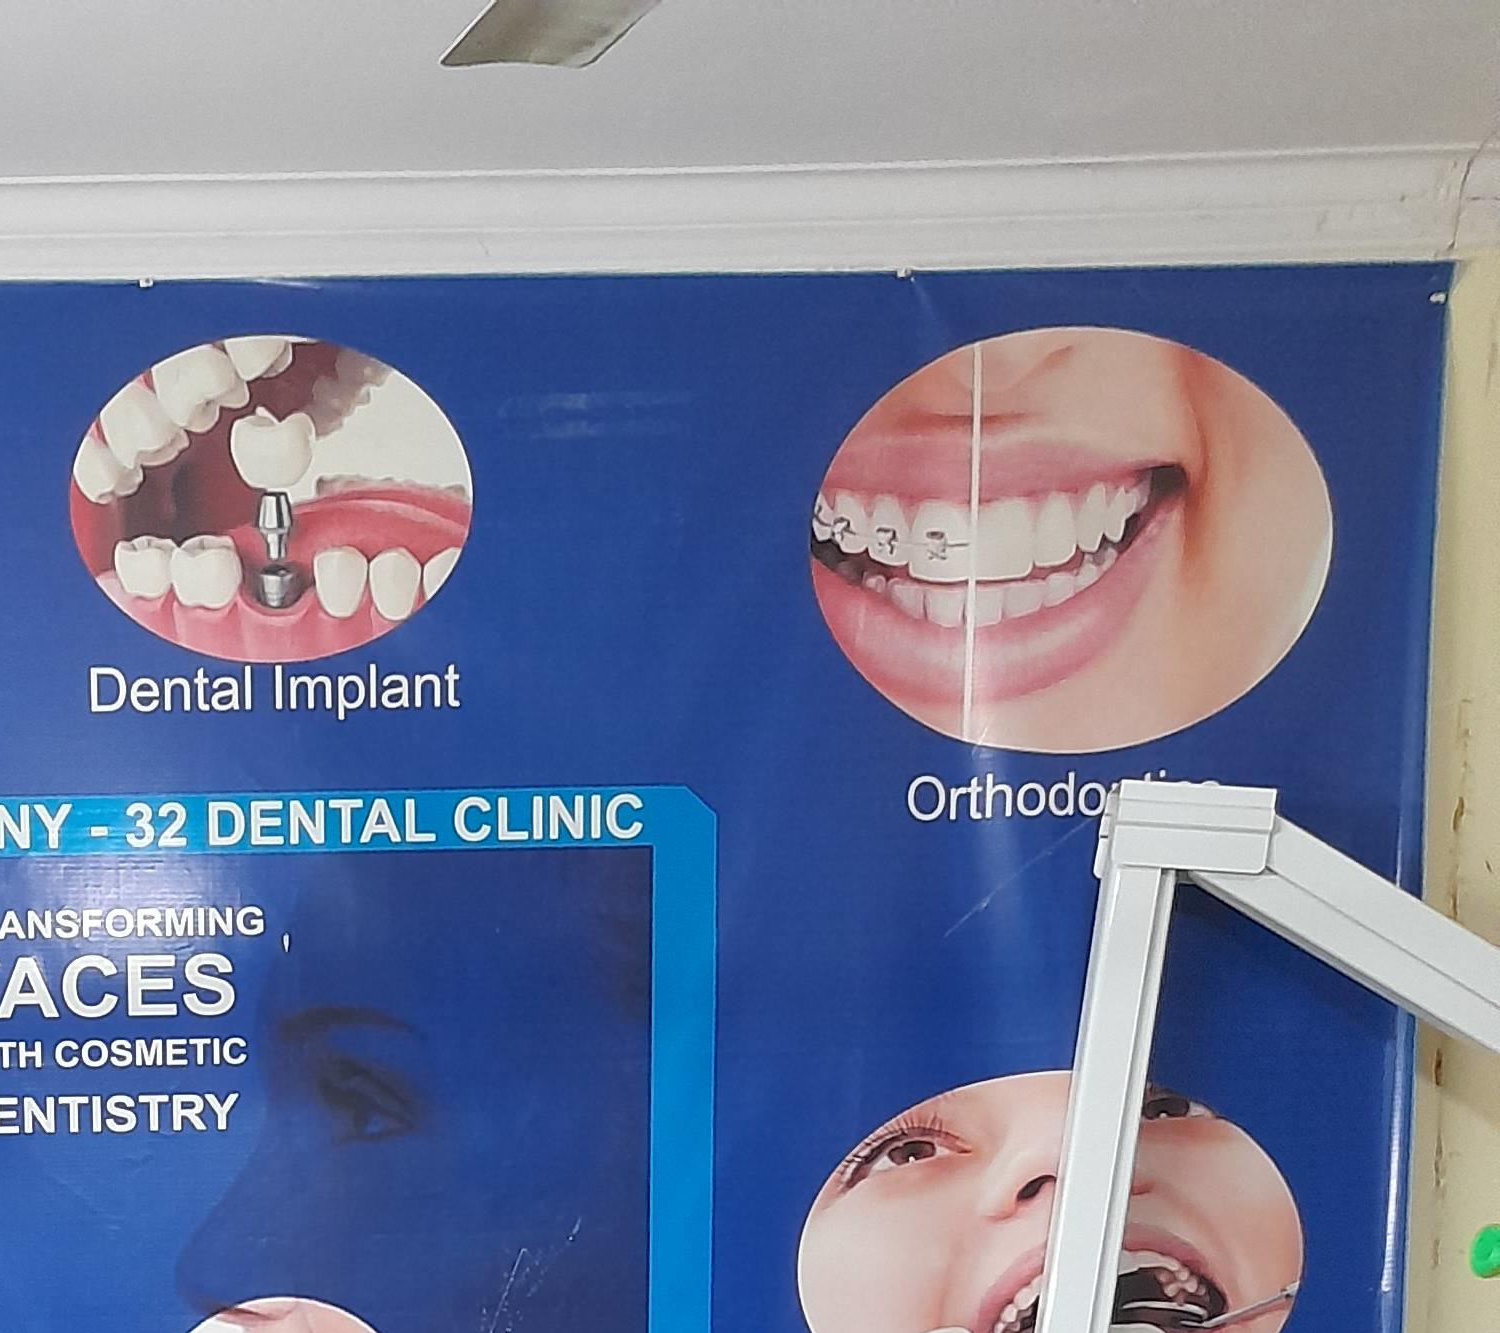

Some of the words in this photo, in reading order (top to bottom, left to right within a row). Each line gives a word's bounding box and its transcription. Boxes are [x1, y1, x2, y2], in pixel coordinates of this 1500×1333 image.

[90, 664, 252, 713] Dental
[274, 663, 461, 721] Implant
[125, 801, 188, 850] 32
[207, 796, 436, 847] DENTAL
[453, 793, 644, 842] CLINIC
[907, 771, 1219, 821] Orthodo
[53, 1036, 248, 1069] COSMETIC
